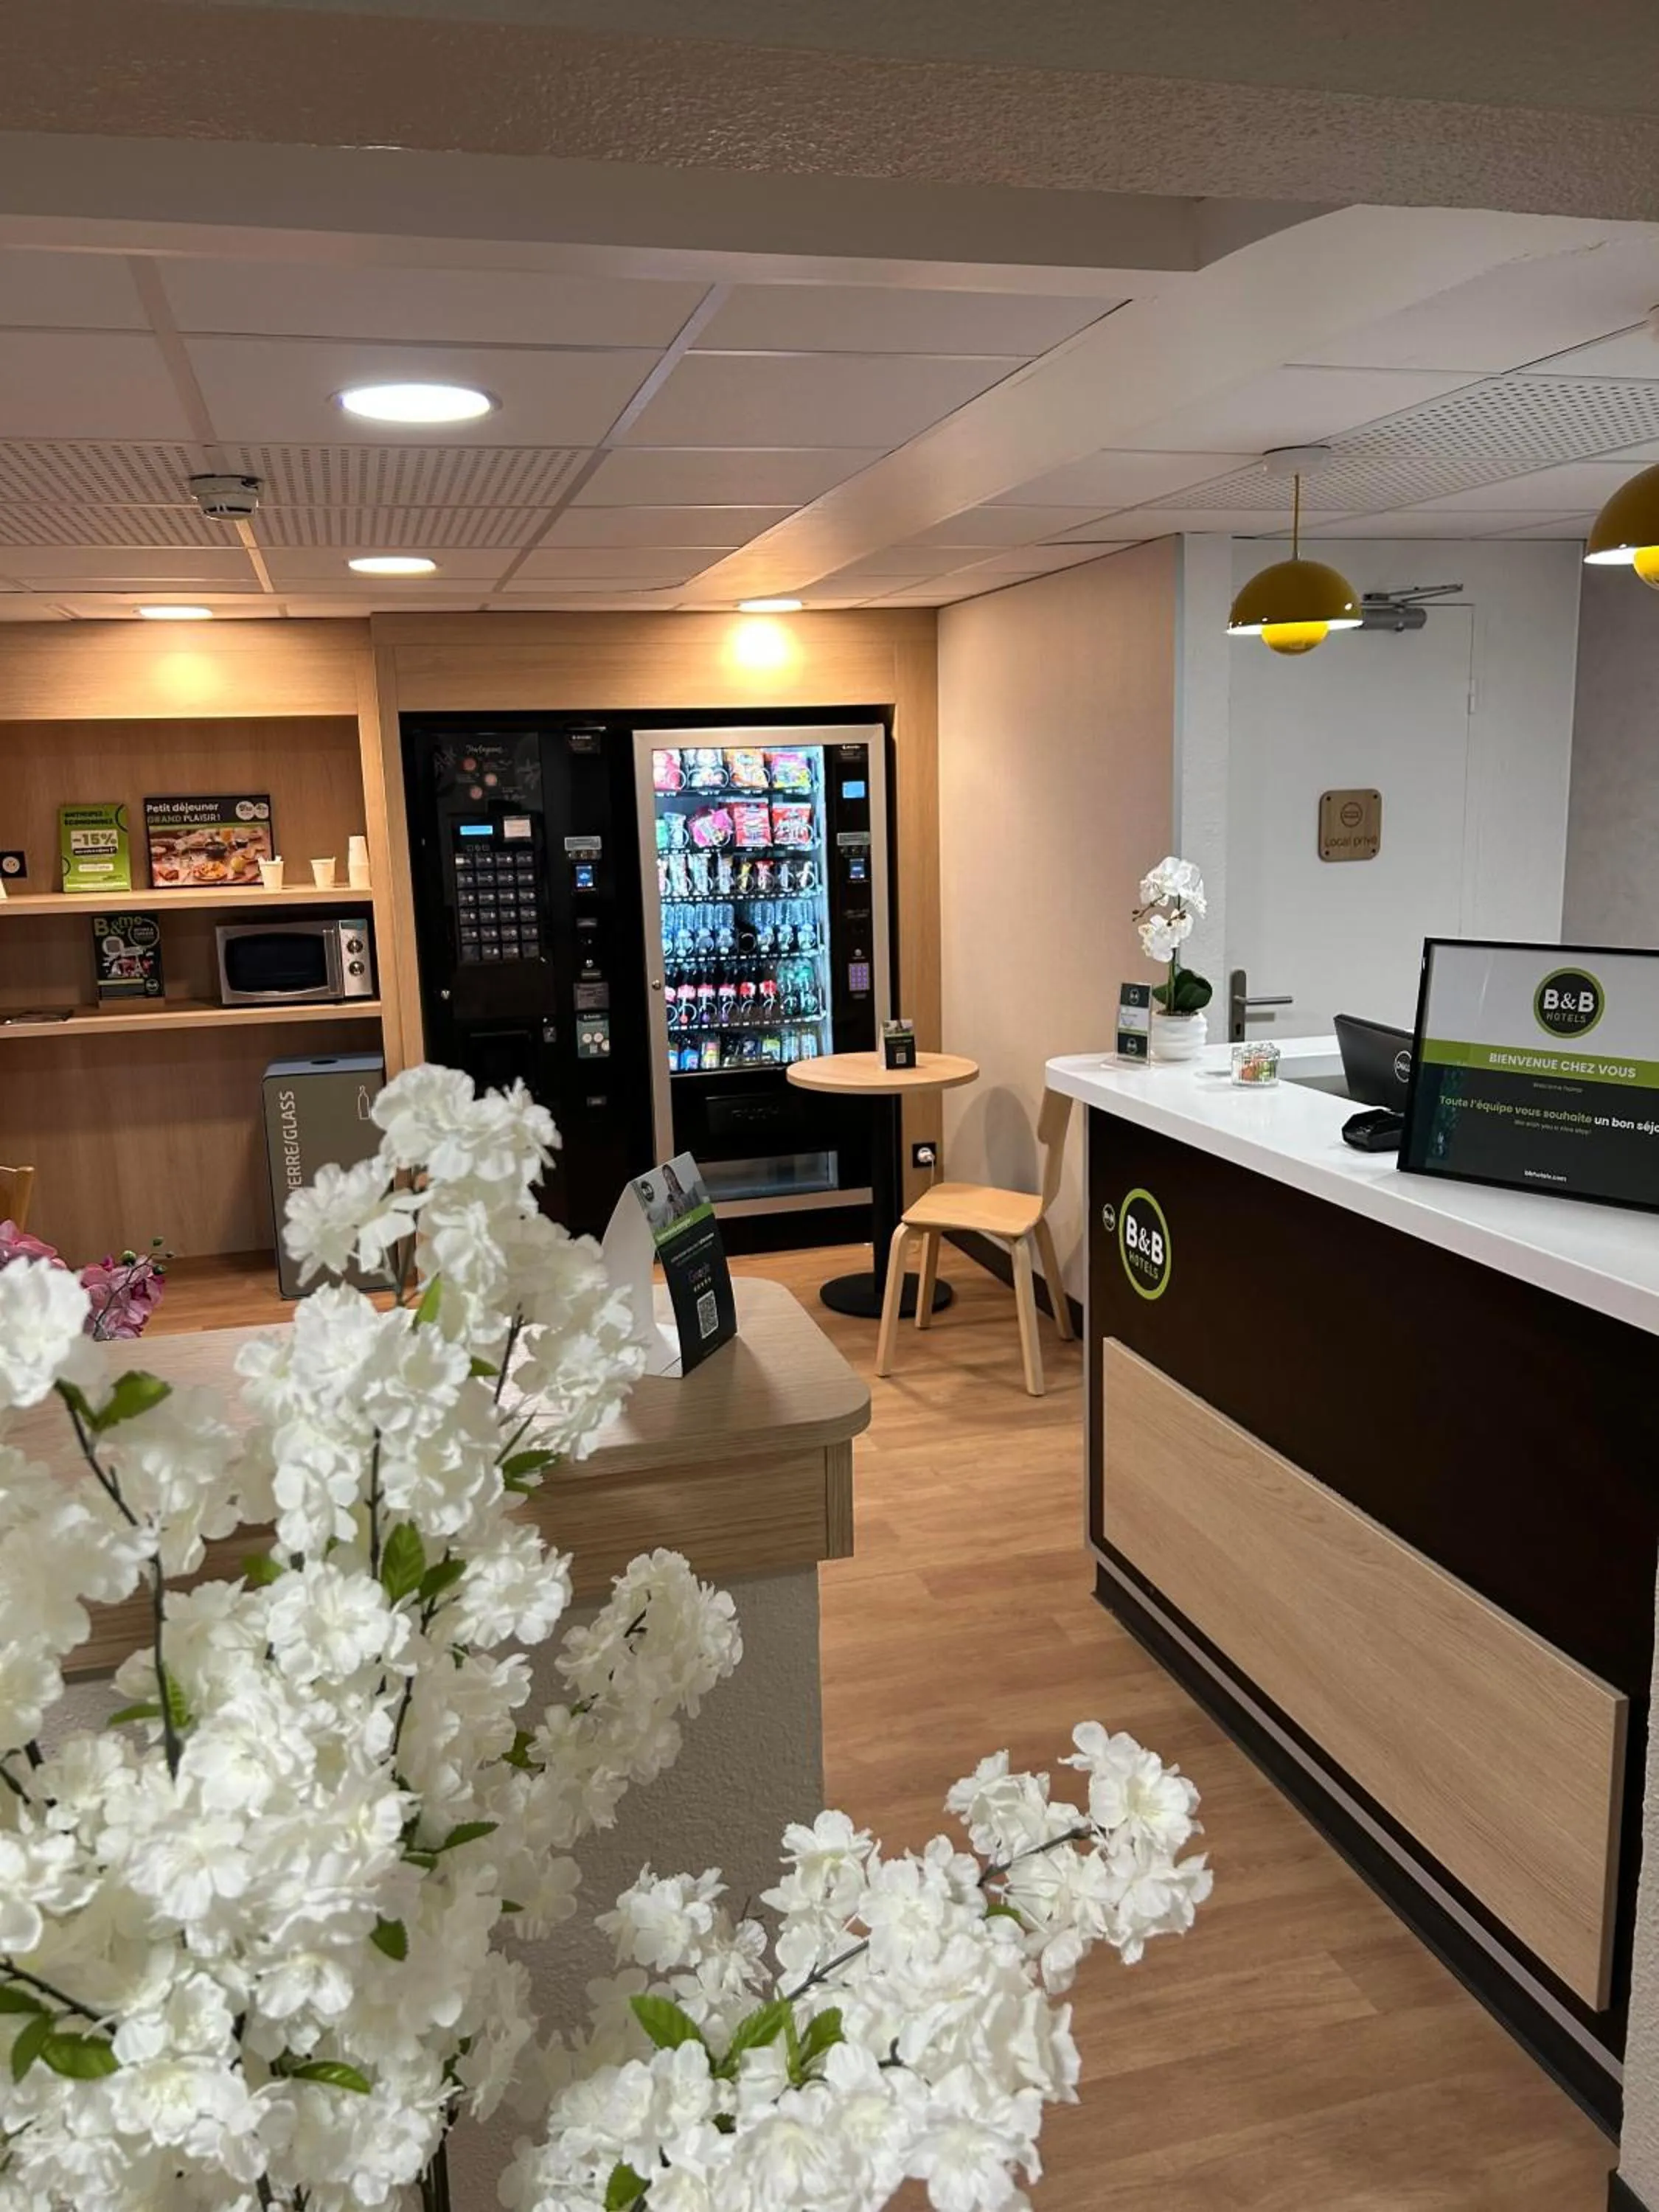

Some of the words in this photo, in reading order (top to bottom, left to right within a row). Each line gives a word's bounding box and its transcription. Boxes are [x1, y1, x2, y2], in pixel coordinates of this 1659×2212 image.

[147, 804, 170, 813] Petit
[72, 833, 117, 846] -15%
[1543, 988, 1596, 1014] B&B
[1545, 1012, 1587, 1024] HOTELS
[1489, 1052, 1559, 1070] BIENVENUE
[1560, 1060, 1596, 1075] CHEZ
[1598, 1064, 1637, 1079] VOUS
[1440, 1095, 1468, 1107] Toute
[1514, 1106, 1543, 1117] vous
[1543, 1110, 1593, 1124] souhaite
[1594, 1116, 1610, 1127] un
[1611, 1117, 1635, 1130] bon
[1126, 1214, 1164, 1265] B&B
[1129, 1250, 1159, 1279] HOTELS
